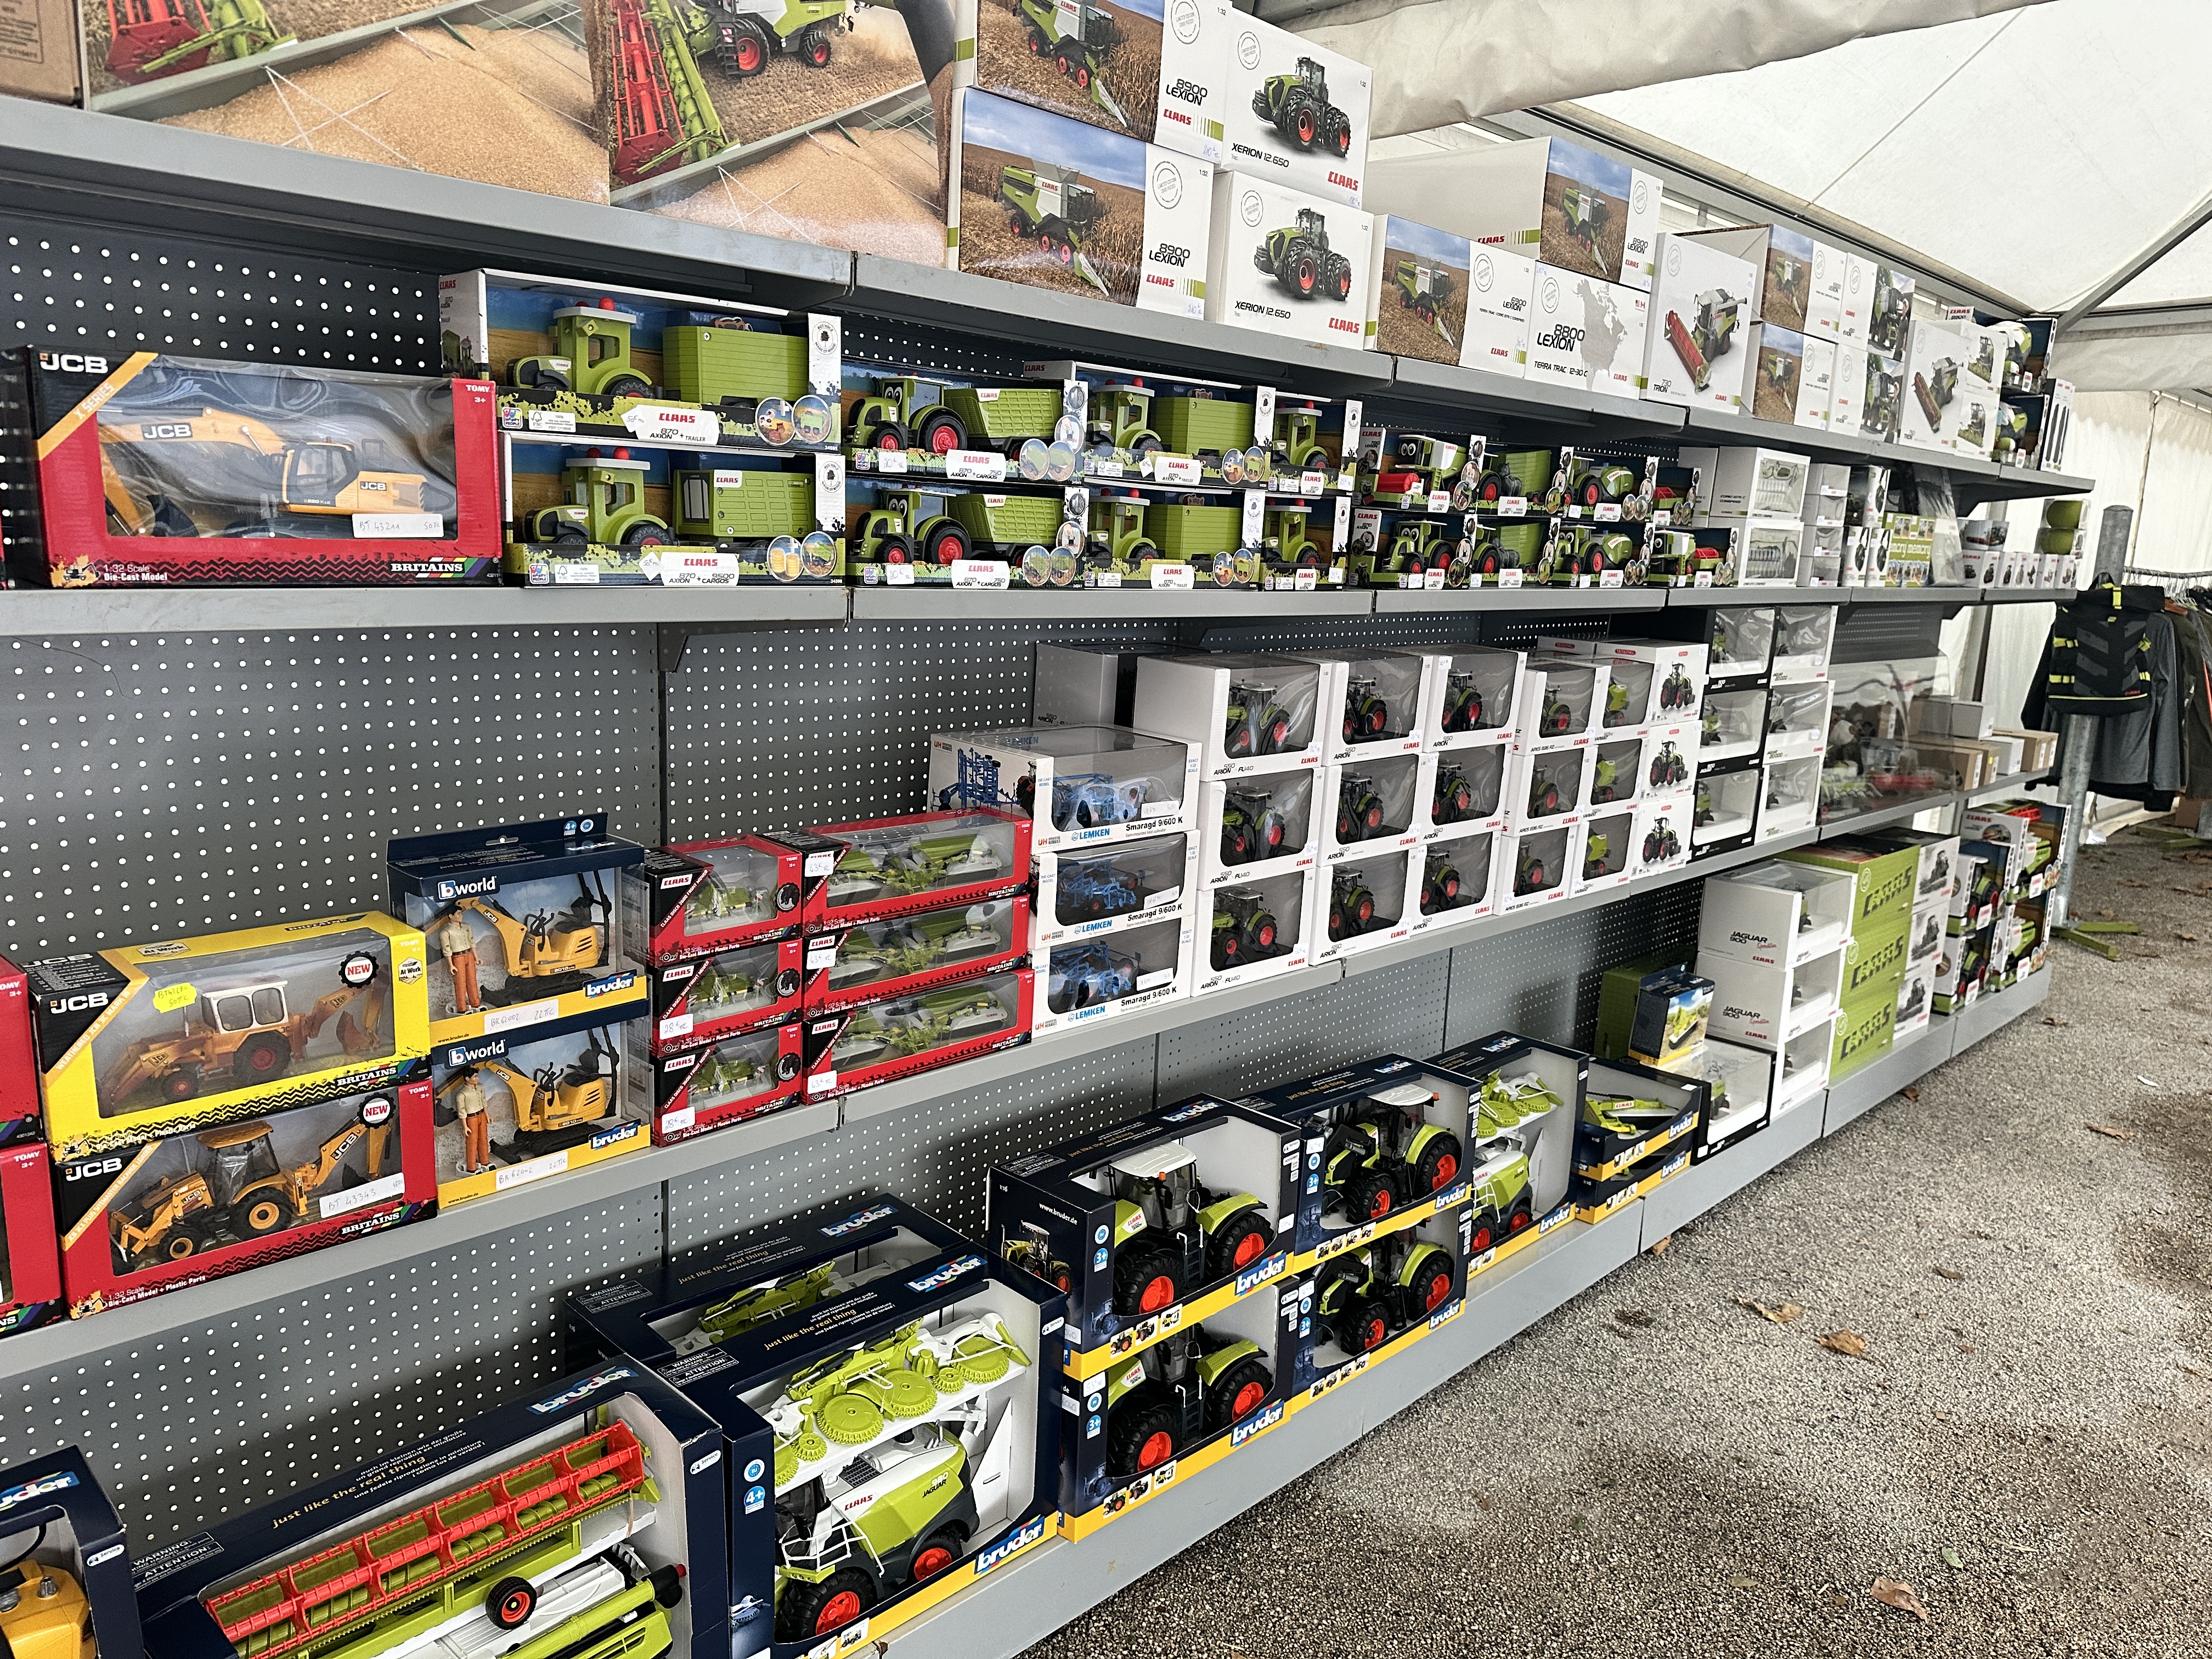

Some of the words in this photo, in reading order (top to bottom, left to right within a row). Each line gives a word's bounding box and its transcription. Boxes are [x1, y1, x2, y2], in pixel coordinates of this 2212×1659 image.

[1166, 84, 1203, 106] LEXION
[1176, 79, 1207, 97] 8900
[1232, 143, 1263, 160] XERION
[1263, 153, 1289, 168] 12.650
[1327, 171, 1359, 191] CLAAS
[1149, 250, 1186, 268] LEXION
[1159, 243, 1190, 259] 8900
[1146, 274, 1175, 288] CLAAS
[1234, 300, 1265, 315] XERION
[1265, 303, 1291, 319] 12.650
[1503, 301, 1521, 312] LEXION
[1554, 324, 1585, 342] 8800
[1537, 332, 1575, 352] LEXION
[40, 353, 108, 374] JCB
[1534, 361, 1551, 371] TERRA
[1553, 365, 1567, 373] TRAC
[466, 384, 490, 393] TOMY
[72, 408, 83, 420] X
[81, 383, 115, 415] SERIES
[659, 413, 695, 423] CLAAS
[144, 425, 191, 439] JCB
[1168, 461, 1189, 470] CLAAS
[360, 482, 387, 490] JCB
[127, 565, 150, 573] Scale
[391, 563, 463, 572] BRITAINS
[104, 573, 139, 581] Die-Cast
[141, 573, 167, 581] Model
[564, 822, 576, 832] 4+
[1126, 820, 1156, 832] Smaragd
[1158, 817, 1177, 827] 9/600
[1177, 816, 1183, 825] K
[1079, 828, 1110, 840] LEMKEN
[1400, 837, 1417, 845] CLAAS
[1328, 851, 1345, 860] ARION
[1548, 891, 1564, 900] CLAAS
[1127, 911, 1157, 922] Smaragd
[1158, 905, 1176, 916] 9/600
[1082, 920, 1113, 933] LEMKEN
[753, 931, 782, 940] BRITAINS
[811, 938, 833, 947] CLAAS
[1730, 931, 1768, 943] JAGUAR
[1730, 936, 1747, 944] 900
[157, 945, 184, 953] Work
[1320, 949, 1338, 958] ARION
[23, 953, 93, 968] JCB
[347, 963, 371, 975] NEW
[586, 976, 634, 997] bruder
[50, 992, 109, 1014] JCB
[1121, 994, 1151, 1007] Smaragd
[1152, 989, 1171, 999] 9/600
[1075, 1006, 1105, 1019] LEMKEN
[1723, 1006, 1761, 1019] JAGUAR
[1723, 1011, 1740, 1019] 900
[754, 1016, 782, 1026] BRITAINS
[815, 1022, 837, 1031] CLAAS
[449, 1039, 505, 1066] bworld
[496, 1070, 510, 1080] JCB
[1375, 1061, 1413, 1074] bruder
[336, 1067, 397, 1086] BRITAINS
[409, 1085, 428, 1094] TOMY
[365, 1105, 388, 1117] NEW
[755, 1100, 783, 1112] BRITAINS
[1163, 1102, 1220, 1122] bruder
[591, 1126, 637, 1148] bruder
[334, 1134, 358, 1160] JCB
[14, 1151, 41, 1162] TOMY
[66, 1157, 122, 1181] JCB
[1307, 1176, 1319, 1187] 3+
[448, 1192, 479, 1204] www.bruder.de
[1435, 1187, 1467, 1209] bruder
[821, 1205, 894, 1237] bruder
[1039, 1201, 1078, 1226] www.bruder.de
[1541, 1205, 1570, 1233] bruder
[341, 1212, 400, 1234] BRITAINS
[696, 1269, 712, 1278] like
[713, 1263, 728, 1272] the
[729, 1258, 744, 1267] real
[745, 1250, 769, 1260] thing
[1095, 1251, 1107, 1263] 3+
[909, 1257, 983, 1291] bruder
[1237, 1257, 1284, 1293] bruder
[108, 1296, 137, 1307] Die-Cast
[138, 1288, 157, 1299] Model
[165, 1280, 187, 1292] Plastic
[188, 1276, 205, 1285] Parts
[1430, 1304, 1460, 1330] bruder
[782, 1332, 799, 1342] like
[799, 1325, 815, 1335] the
[816, 1318, 832, 1328] real
[833, 1309, 857, 1321] thing
[1300, 1321, 1310, 1330] 3+
[531, 1367, 631, 1415] bruder
[1089, 1418, 1101, 1429] 3+
[1233, 1407, 1283, 1442] bruder
[272, 1512, 302, 1528] just
[303, 1499, 330, 1514] like
[331, 1486, 357, 1499] the
[359, 1474, 386, 1488] real
[388, 1457, 426, 1475] thing
[745, 1487, 764, 1504] 4+
[923, 1479, 946, 1498] JAGUAR
[844, 1494, 873, 1511] CLAAS
[133, 1539, 193, 1567] WARNING:
[977, 1521, 1042, 1572] bruder
[144, 1545, 211, 1578] ATTENTION:
